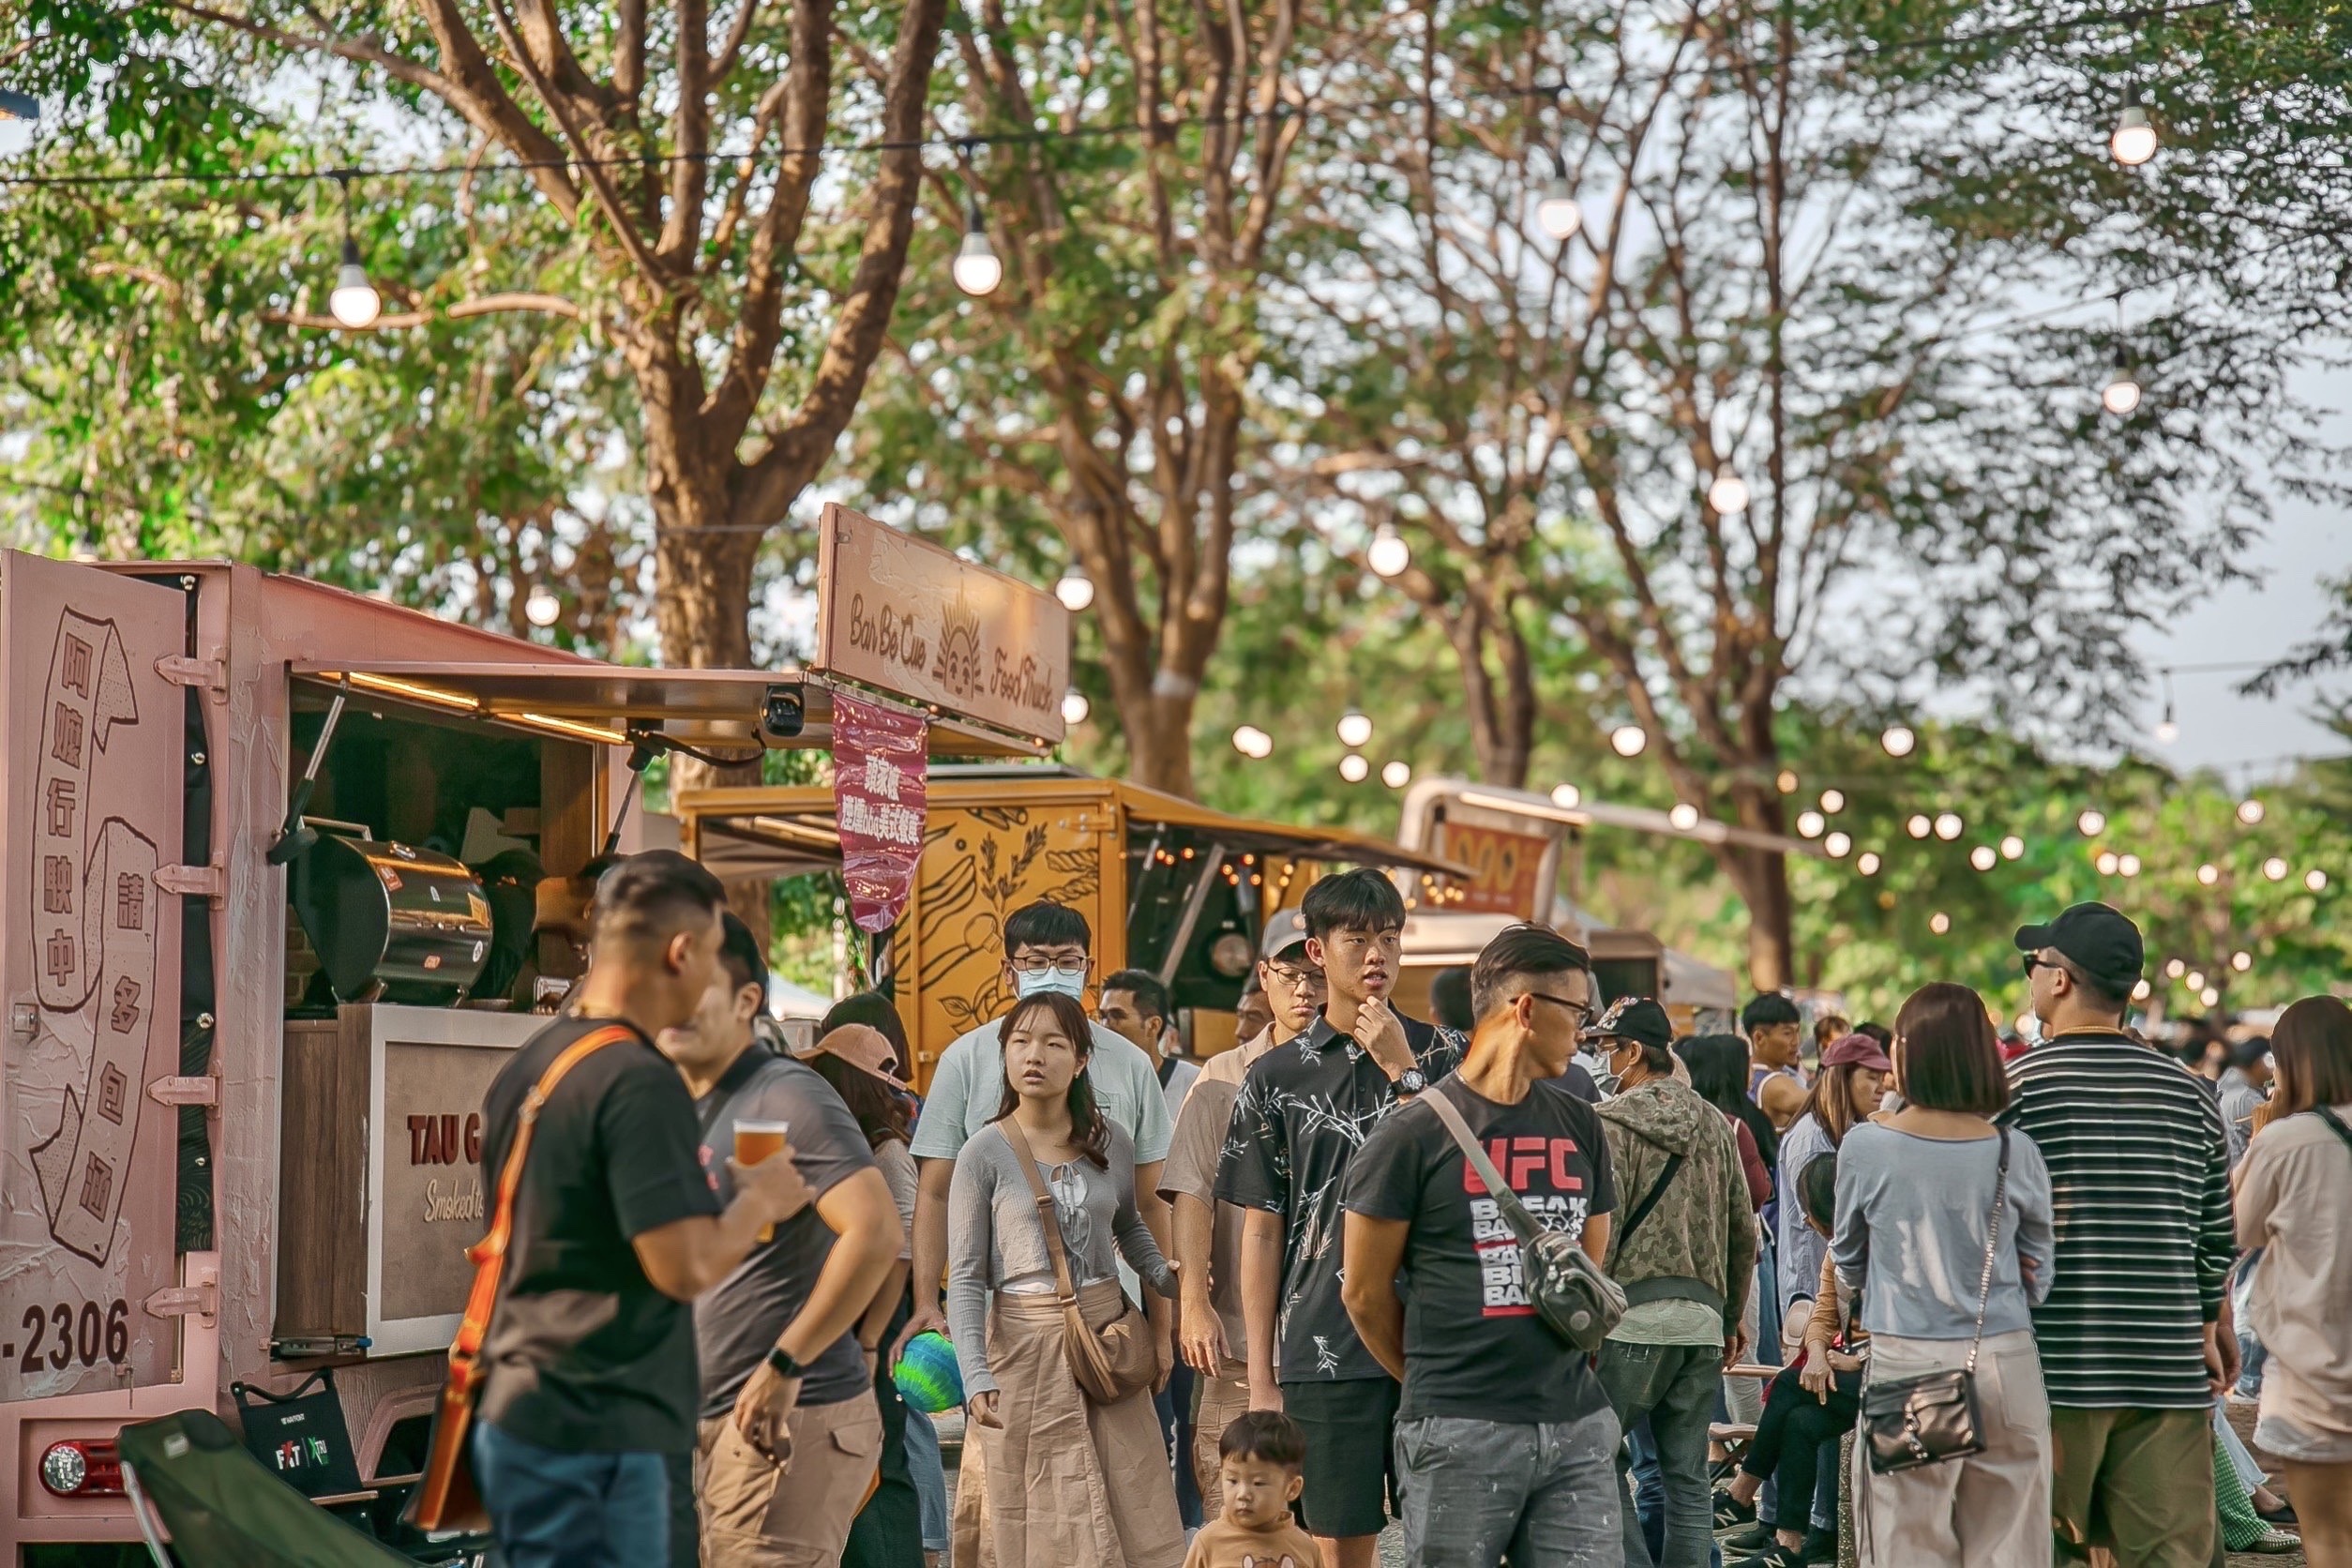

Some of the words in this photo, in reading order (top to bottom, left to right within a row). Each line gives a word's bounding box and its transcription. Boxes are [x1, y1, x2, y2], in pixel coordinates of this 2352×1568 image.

[850, 593, 878, 653] Bar
[880, 604, 898, 660] Be
[900, 613, 927, 671] Cue
[990, 647, 1023, 706] Food
[1023, 655, 1053, 714] Truck
[44, 631, 93, 987] 阿嬤行駛中
[79, 871, 143, 1223] 請多包涵
[407, 1114, 460, 1165] TAU
[464, 1113, 482, 1165] G
[1463, 1137, 1583, 1194] UFC
[424, 1179, 475, 1222] Smoked
[1470, 1196, 1588, 1219] BEAK
[3, 1298, 128, 1373] -2306
